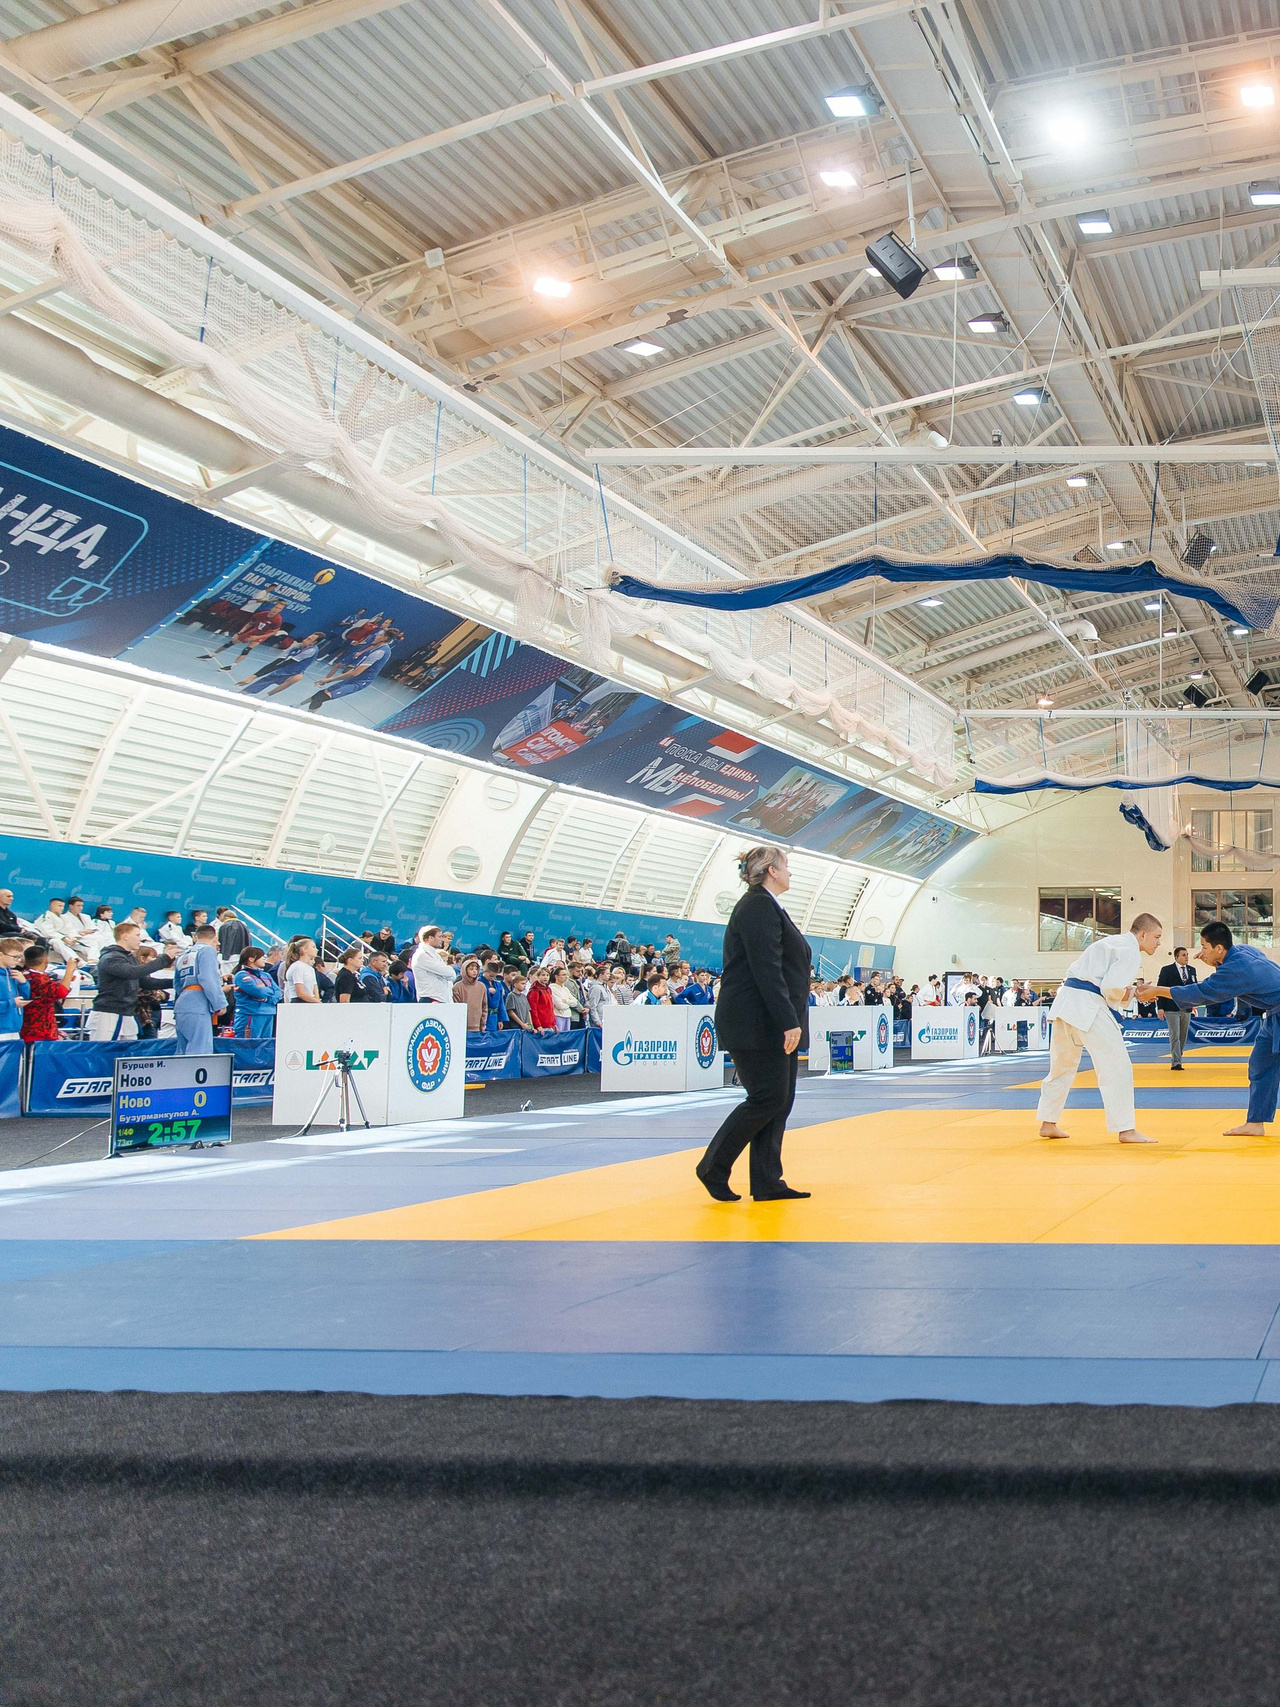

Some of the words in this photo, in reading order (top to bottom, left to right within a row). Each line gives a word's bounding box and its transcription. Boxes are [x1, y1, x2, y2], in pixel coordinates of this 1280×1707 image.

[0, 487, 108, 570] НДА,
[242, 572, 266, 586] ПАО
[219, 592, 247, 606] 2022
[634, 1040, 677, 1052] ГАЗПРОМ
[122, 1061, 154, 1071] Бурцев
[540, 1057, 559, 1065] START
[562, 1054, 578, 1063] LINE
[120, 1074, 152, 1087] Ново
[195, 1068, 208, 1084] 0
[233, 1073, 268, 1084] TART
[63, 1080, 112, 1094] STAR
[119, 1095, 151, 1109] Ново
[194, 1090, 207, 1108] 0
[147, 1119, 202, 1144] 2:57
